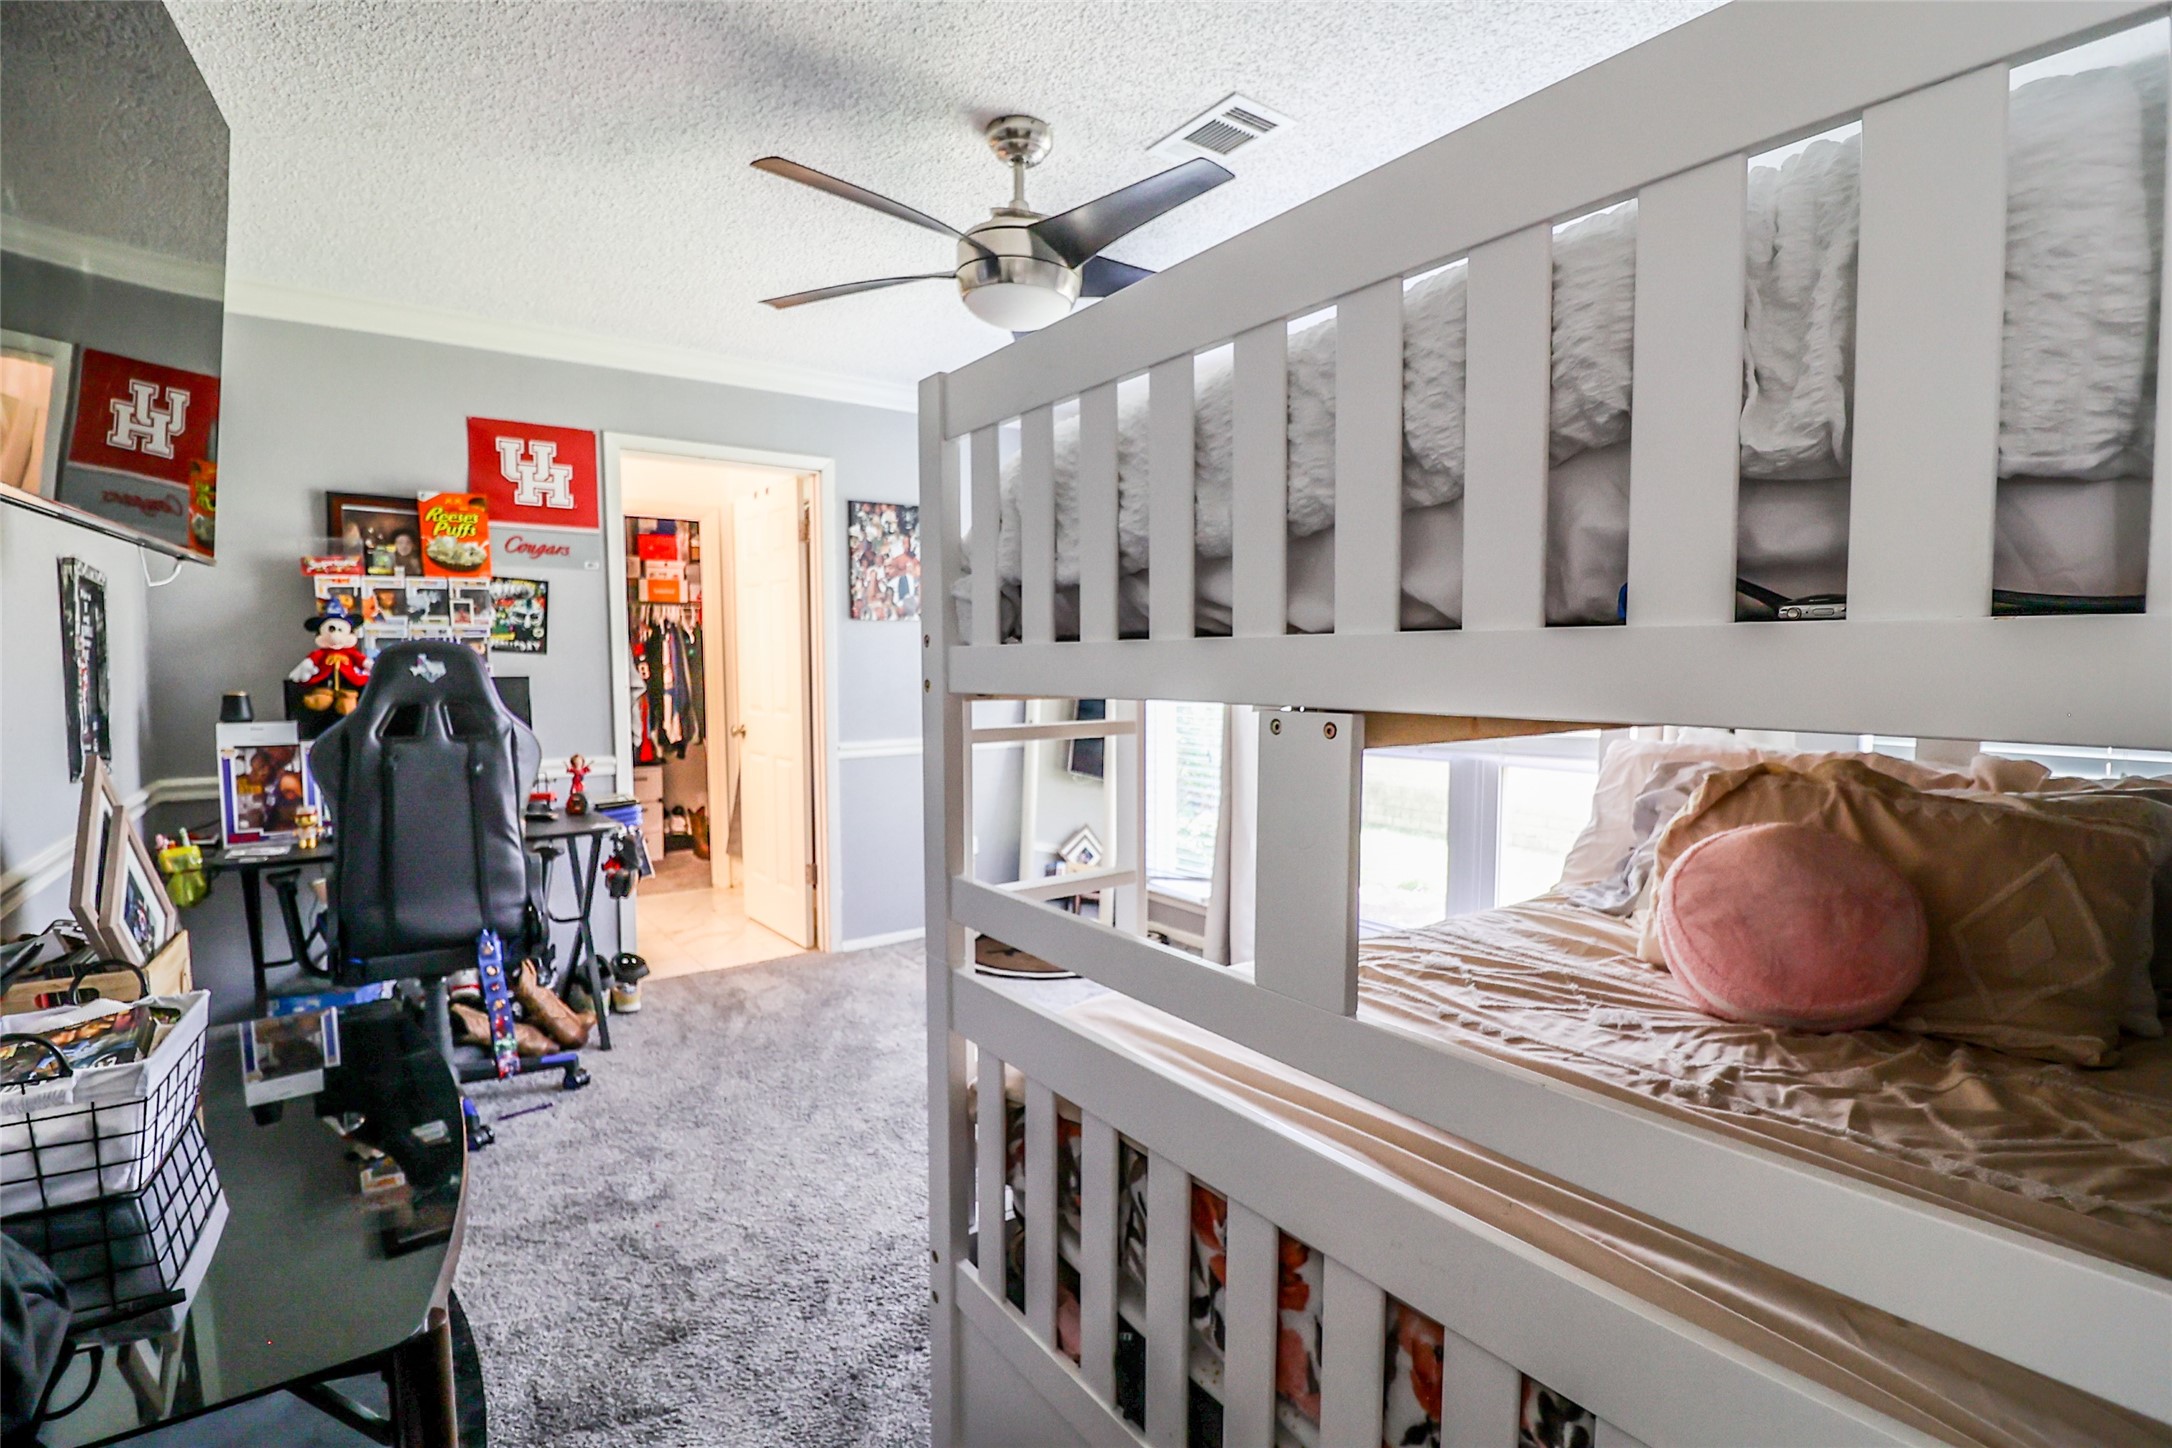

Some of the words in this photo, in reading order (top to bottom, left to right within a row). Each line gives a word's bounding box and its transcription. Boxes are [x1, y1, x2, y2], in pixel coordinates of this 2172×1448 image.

[495, 436, 574, 509] UH
[432, 520, 477, 539] Puffs
[504, 535, 570, 559] Cougars
